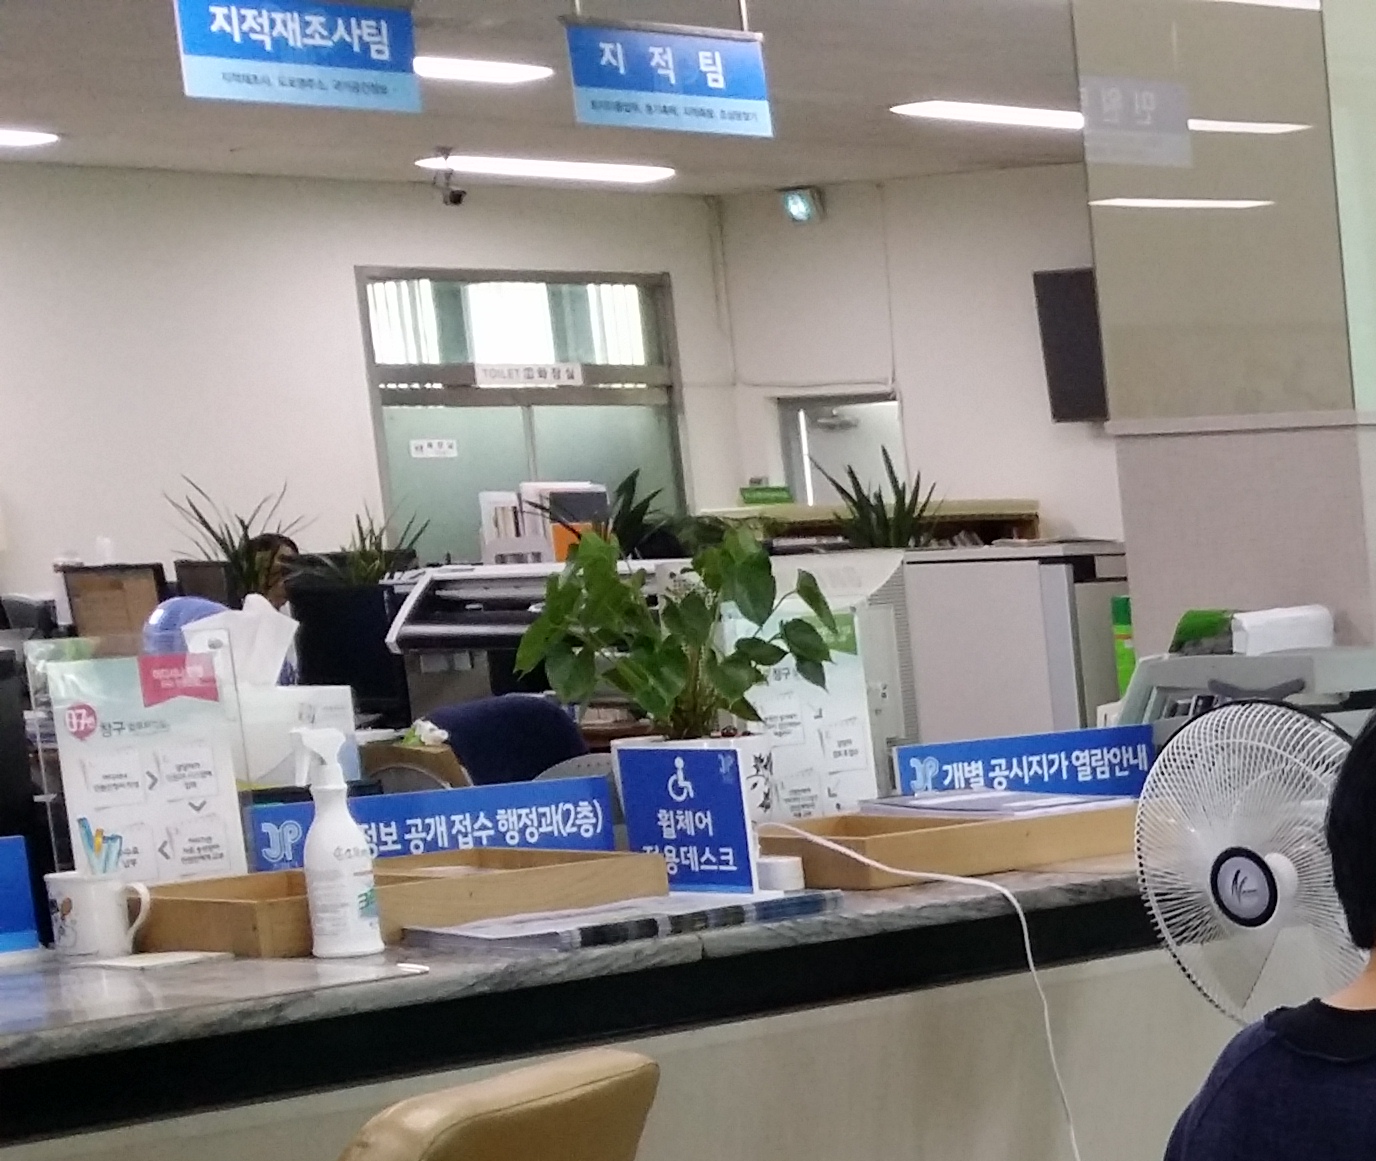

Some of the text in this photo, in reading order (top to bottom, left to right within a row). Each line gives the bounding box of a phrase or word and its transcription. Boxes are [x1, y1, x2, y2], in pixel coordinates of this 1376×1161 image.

[208, 5, 391, 61] 지적재조사팀
[942, 743, 1149, 790] 개별 공시지가 열람안내
[403, 814, 450, 855] 공개
[450, 810, 495, 851] 접수
[495, 798, 604, 847] 행정과(2층)
[656, 809, 714, 840] 휠체어
